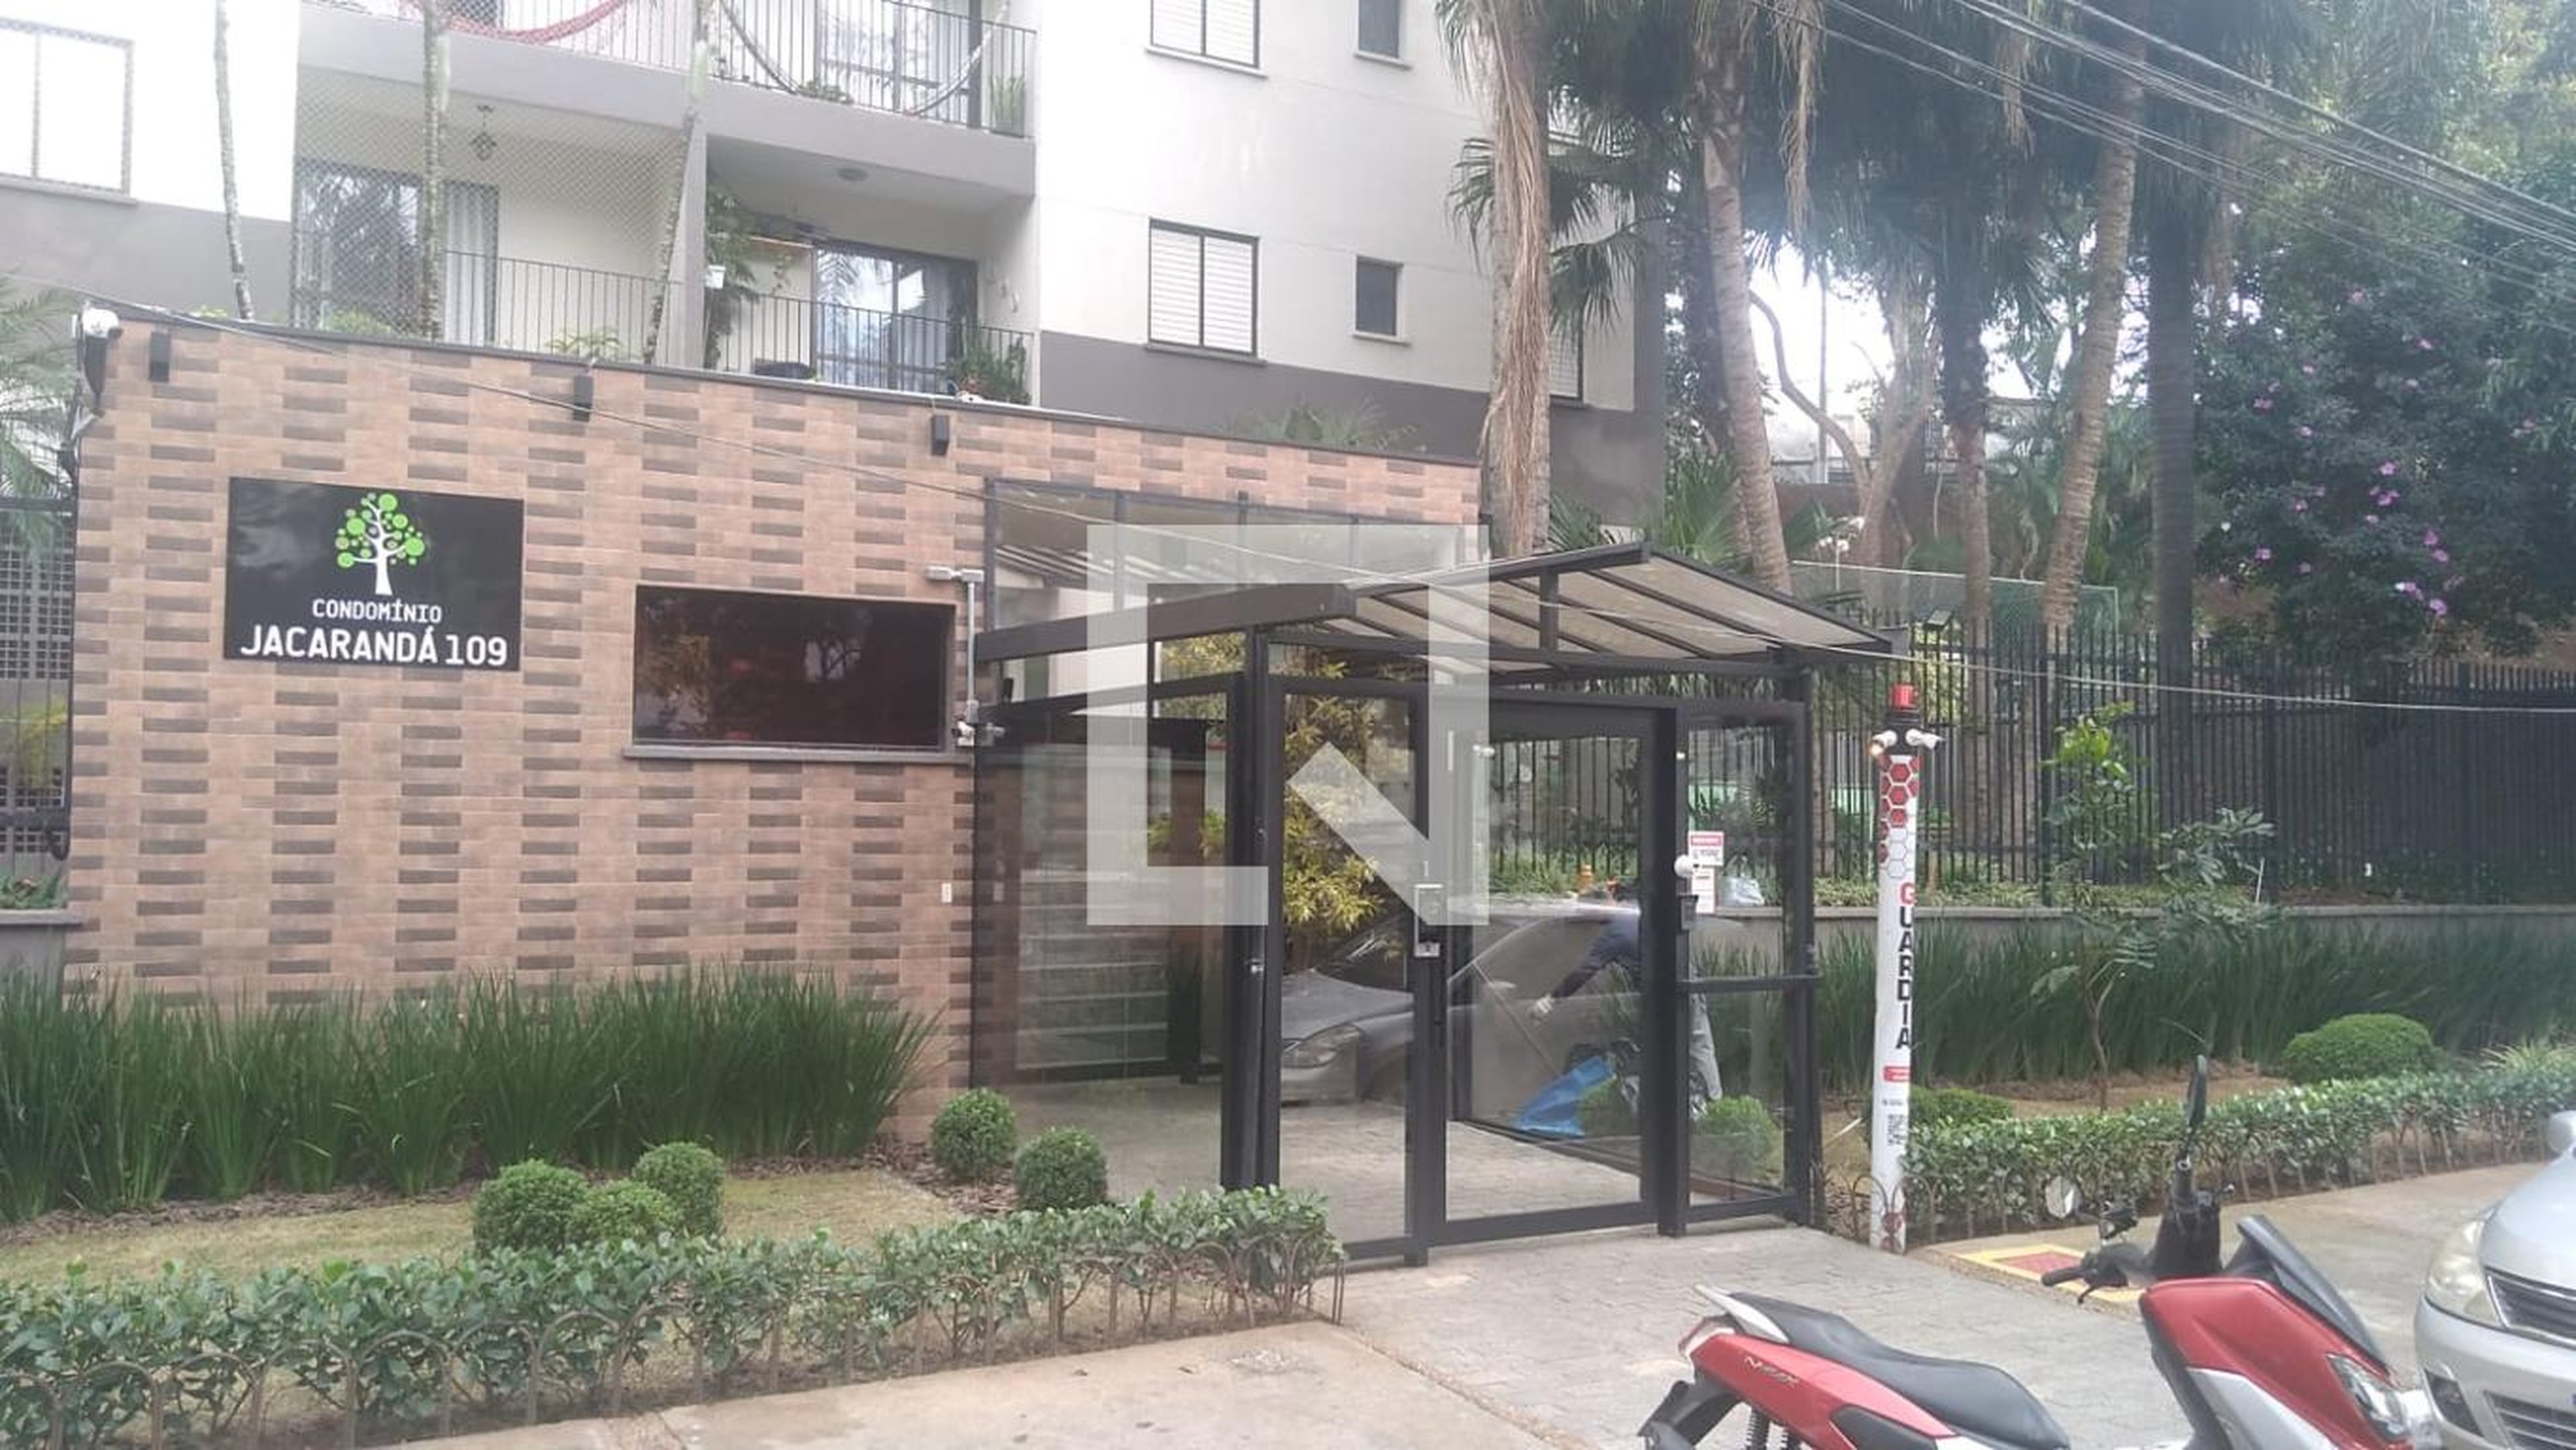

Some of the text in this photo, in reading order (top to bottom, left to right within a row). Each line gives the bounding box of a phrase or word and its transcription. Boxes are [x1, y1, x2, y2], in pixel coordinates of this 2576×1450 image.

[312, 598, 442, 623] CONDOMÍNIO
[240, 624, 508, 666] JACARANDÁ 109
